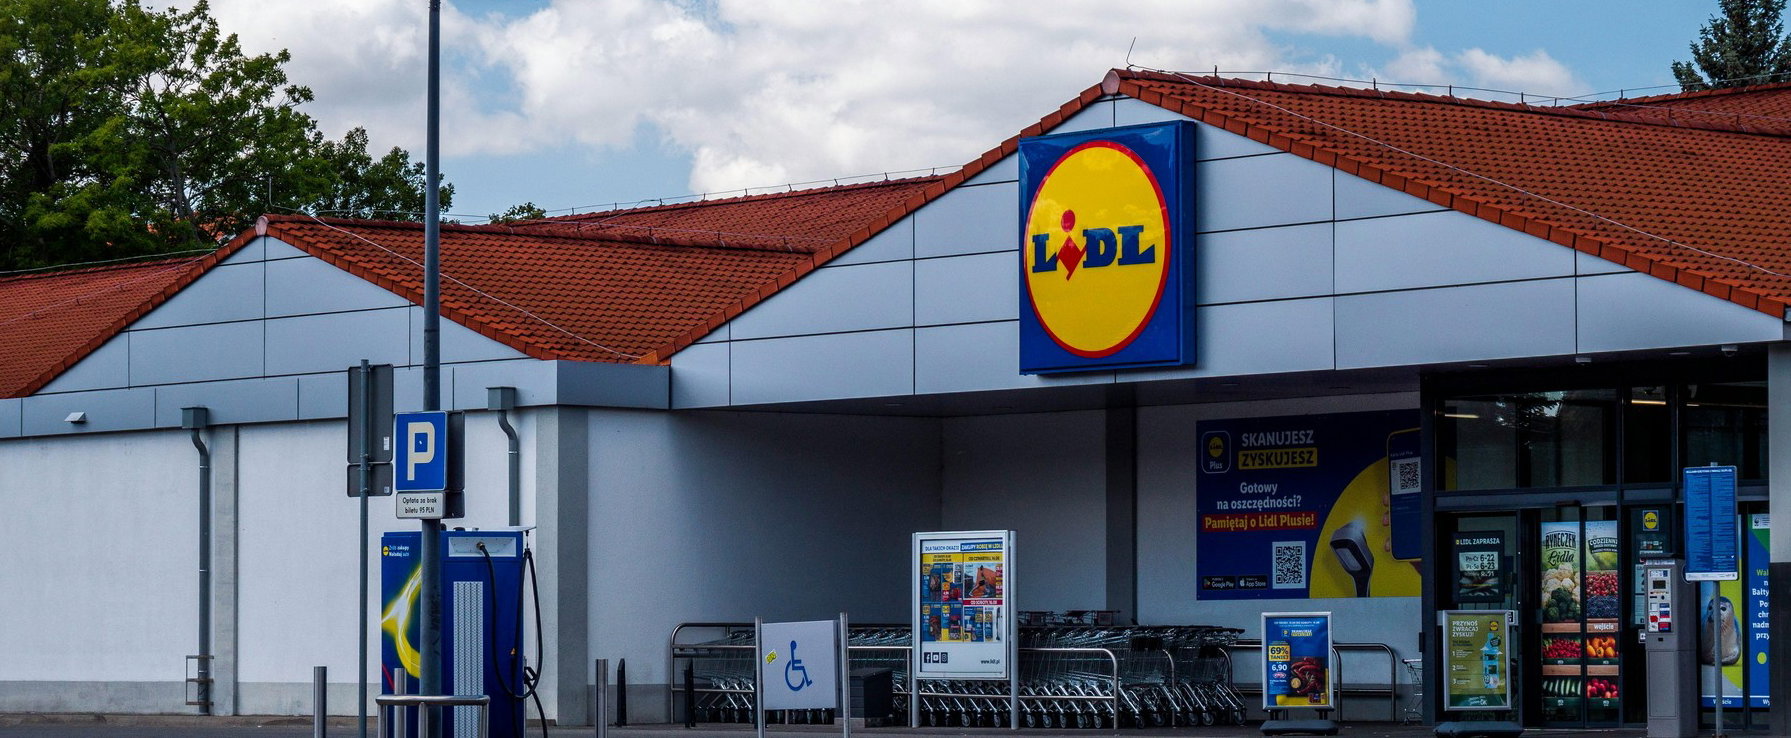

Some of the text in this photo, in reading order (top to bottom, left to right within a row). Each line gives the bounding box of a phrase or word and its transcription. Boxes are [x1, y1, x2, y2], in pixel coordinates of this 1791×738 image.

[1242, 430, 1314, 447] SKANUJESZ
[408, 422, 435, 480] P
[1242, 450, 1314, 466] ZYSKUJESZ
[1210, 461, 1222, 470] Plus
[1240, 482, 1278, 495] Gotowy
[1217, 496, 1302, 511] na oszczędności?
[1205, 513, 1314, 530] Pamiętaj o Lidl Plusie!
[1546, 533, 1576, 550] RYNECZEK
[1548, 551, 1574, 566] Lidla
[1270, 646, 1288, 654] 69%
